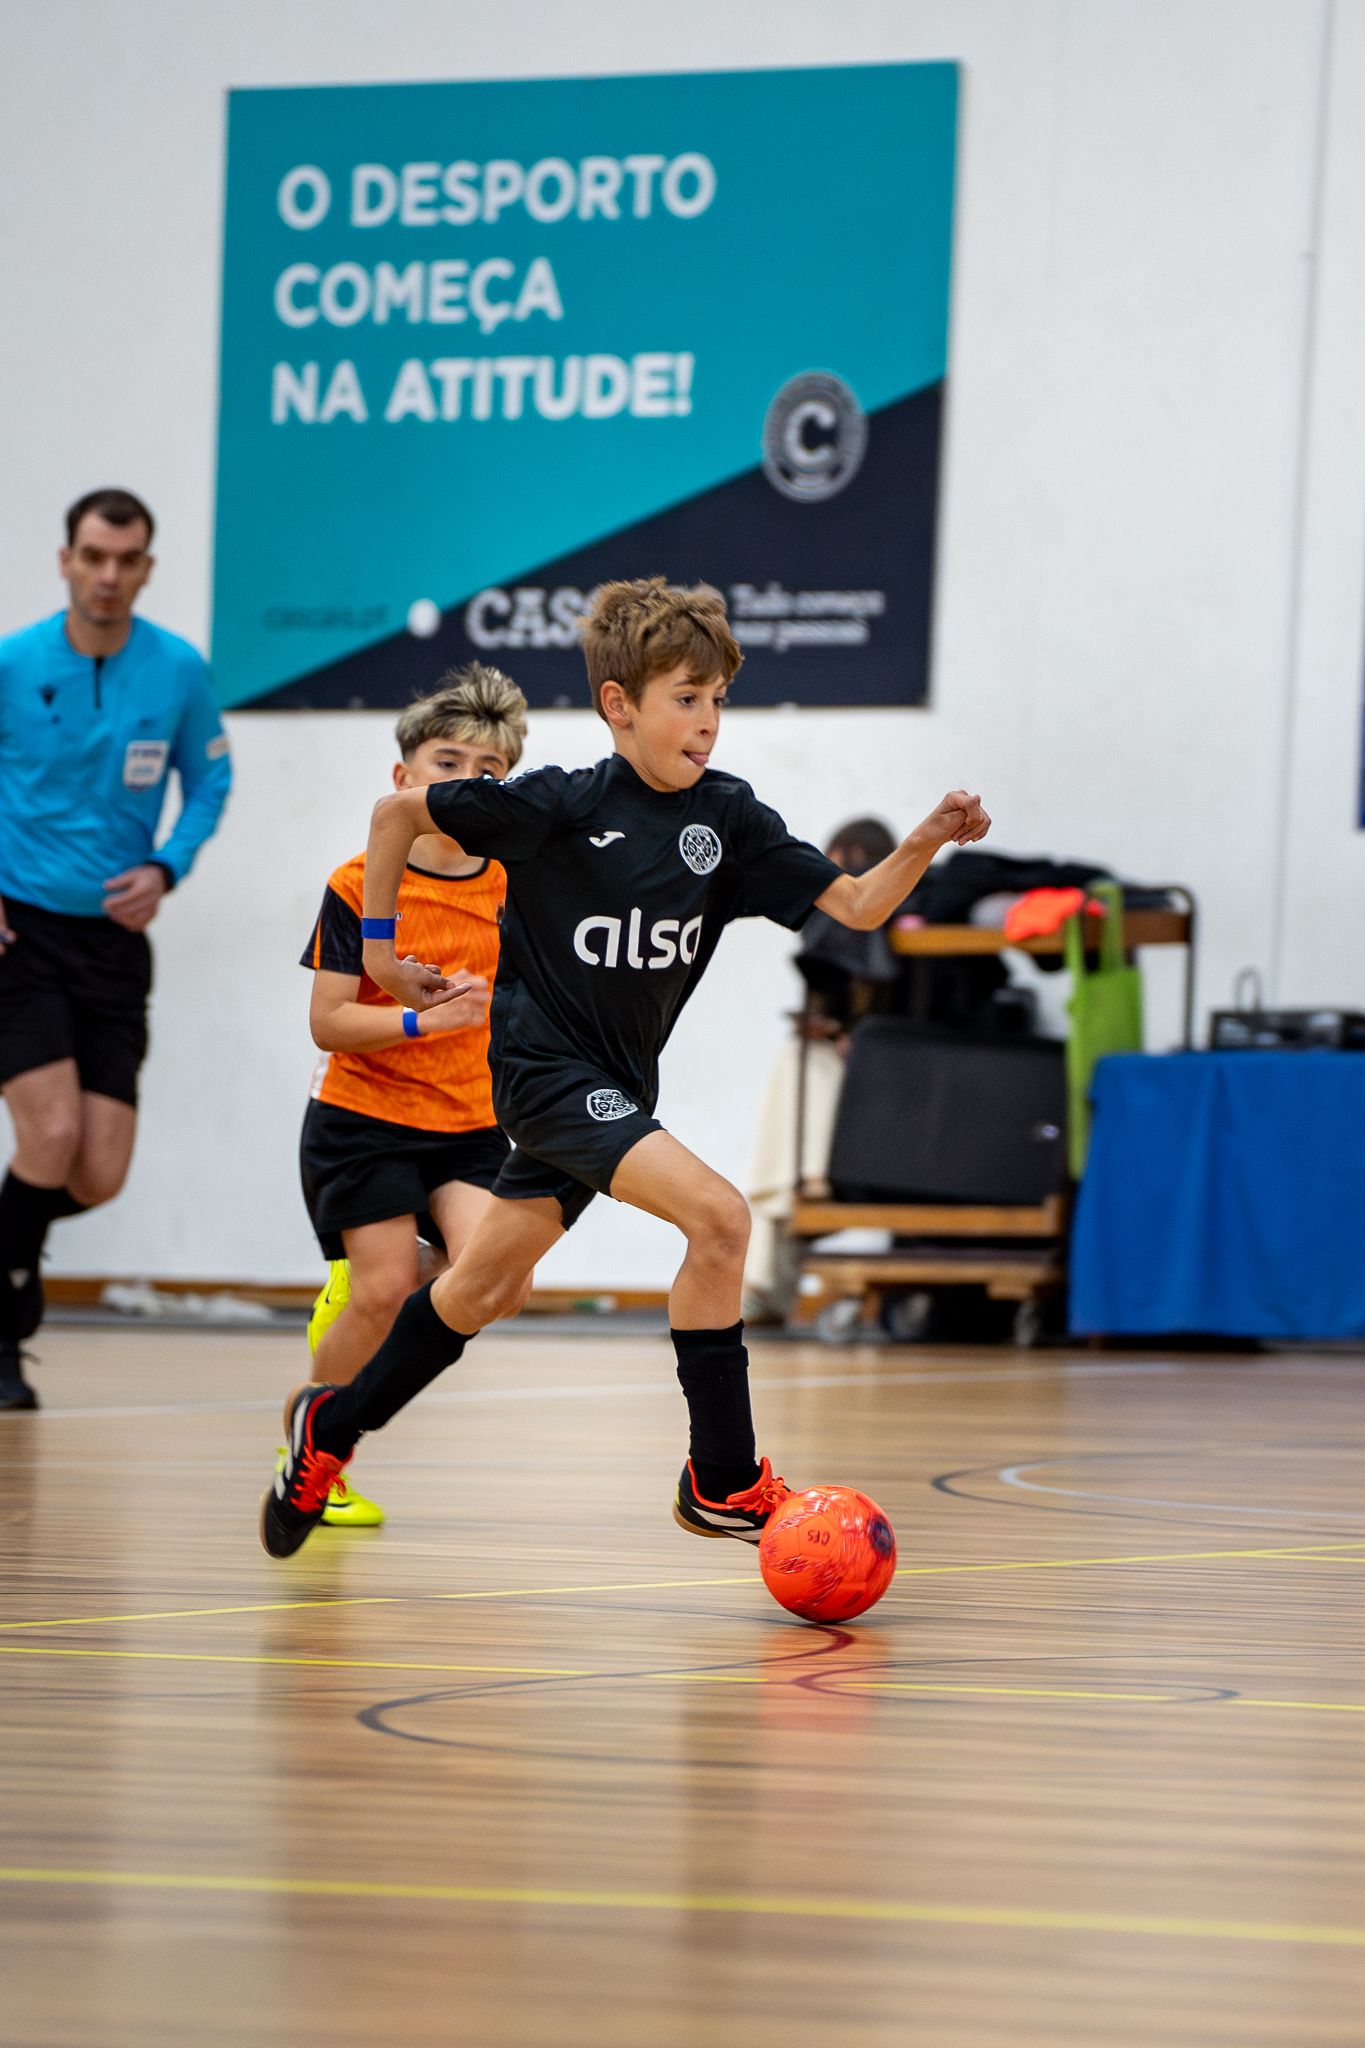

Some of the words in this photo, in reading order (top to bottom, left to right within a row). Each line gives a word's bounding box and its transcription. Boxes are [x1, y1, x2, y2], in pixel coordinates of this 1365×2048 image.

[278, 165, 330, 229] O
[351, 152, 717, 227] DESPORTO
[275, 258, 563, 333] COMEÇA
[272, 361, 367, 423] NA
[385, 352, 694, 422] ATITUDE!
[785, 401, 836, 466] C
